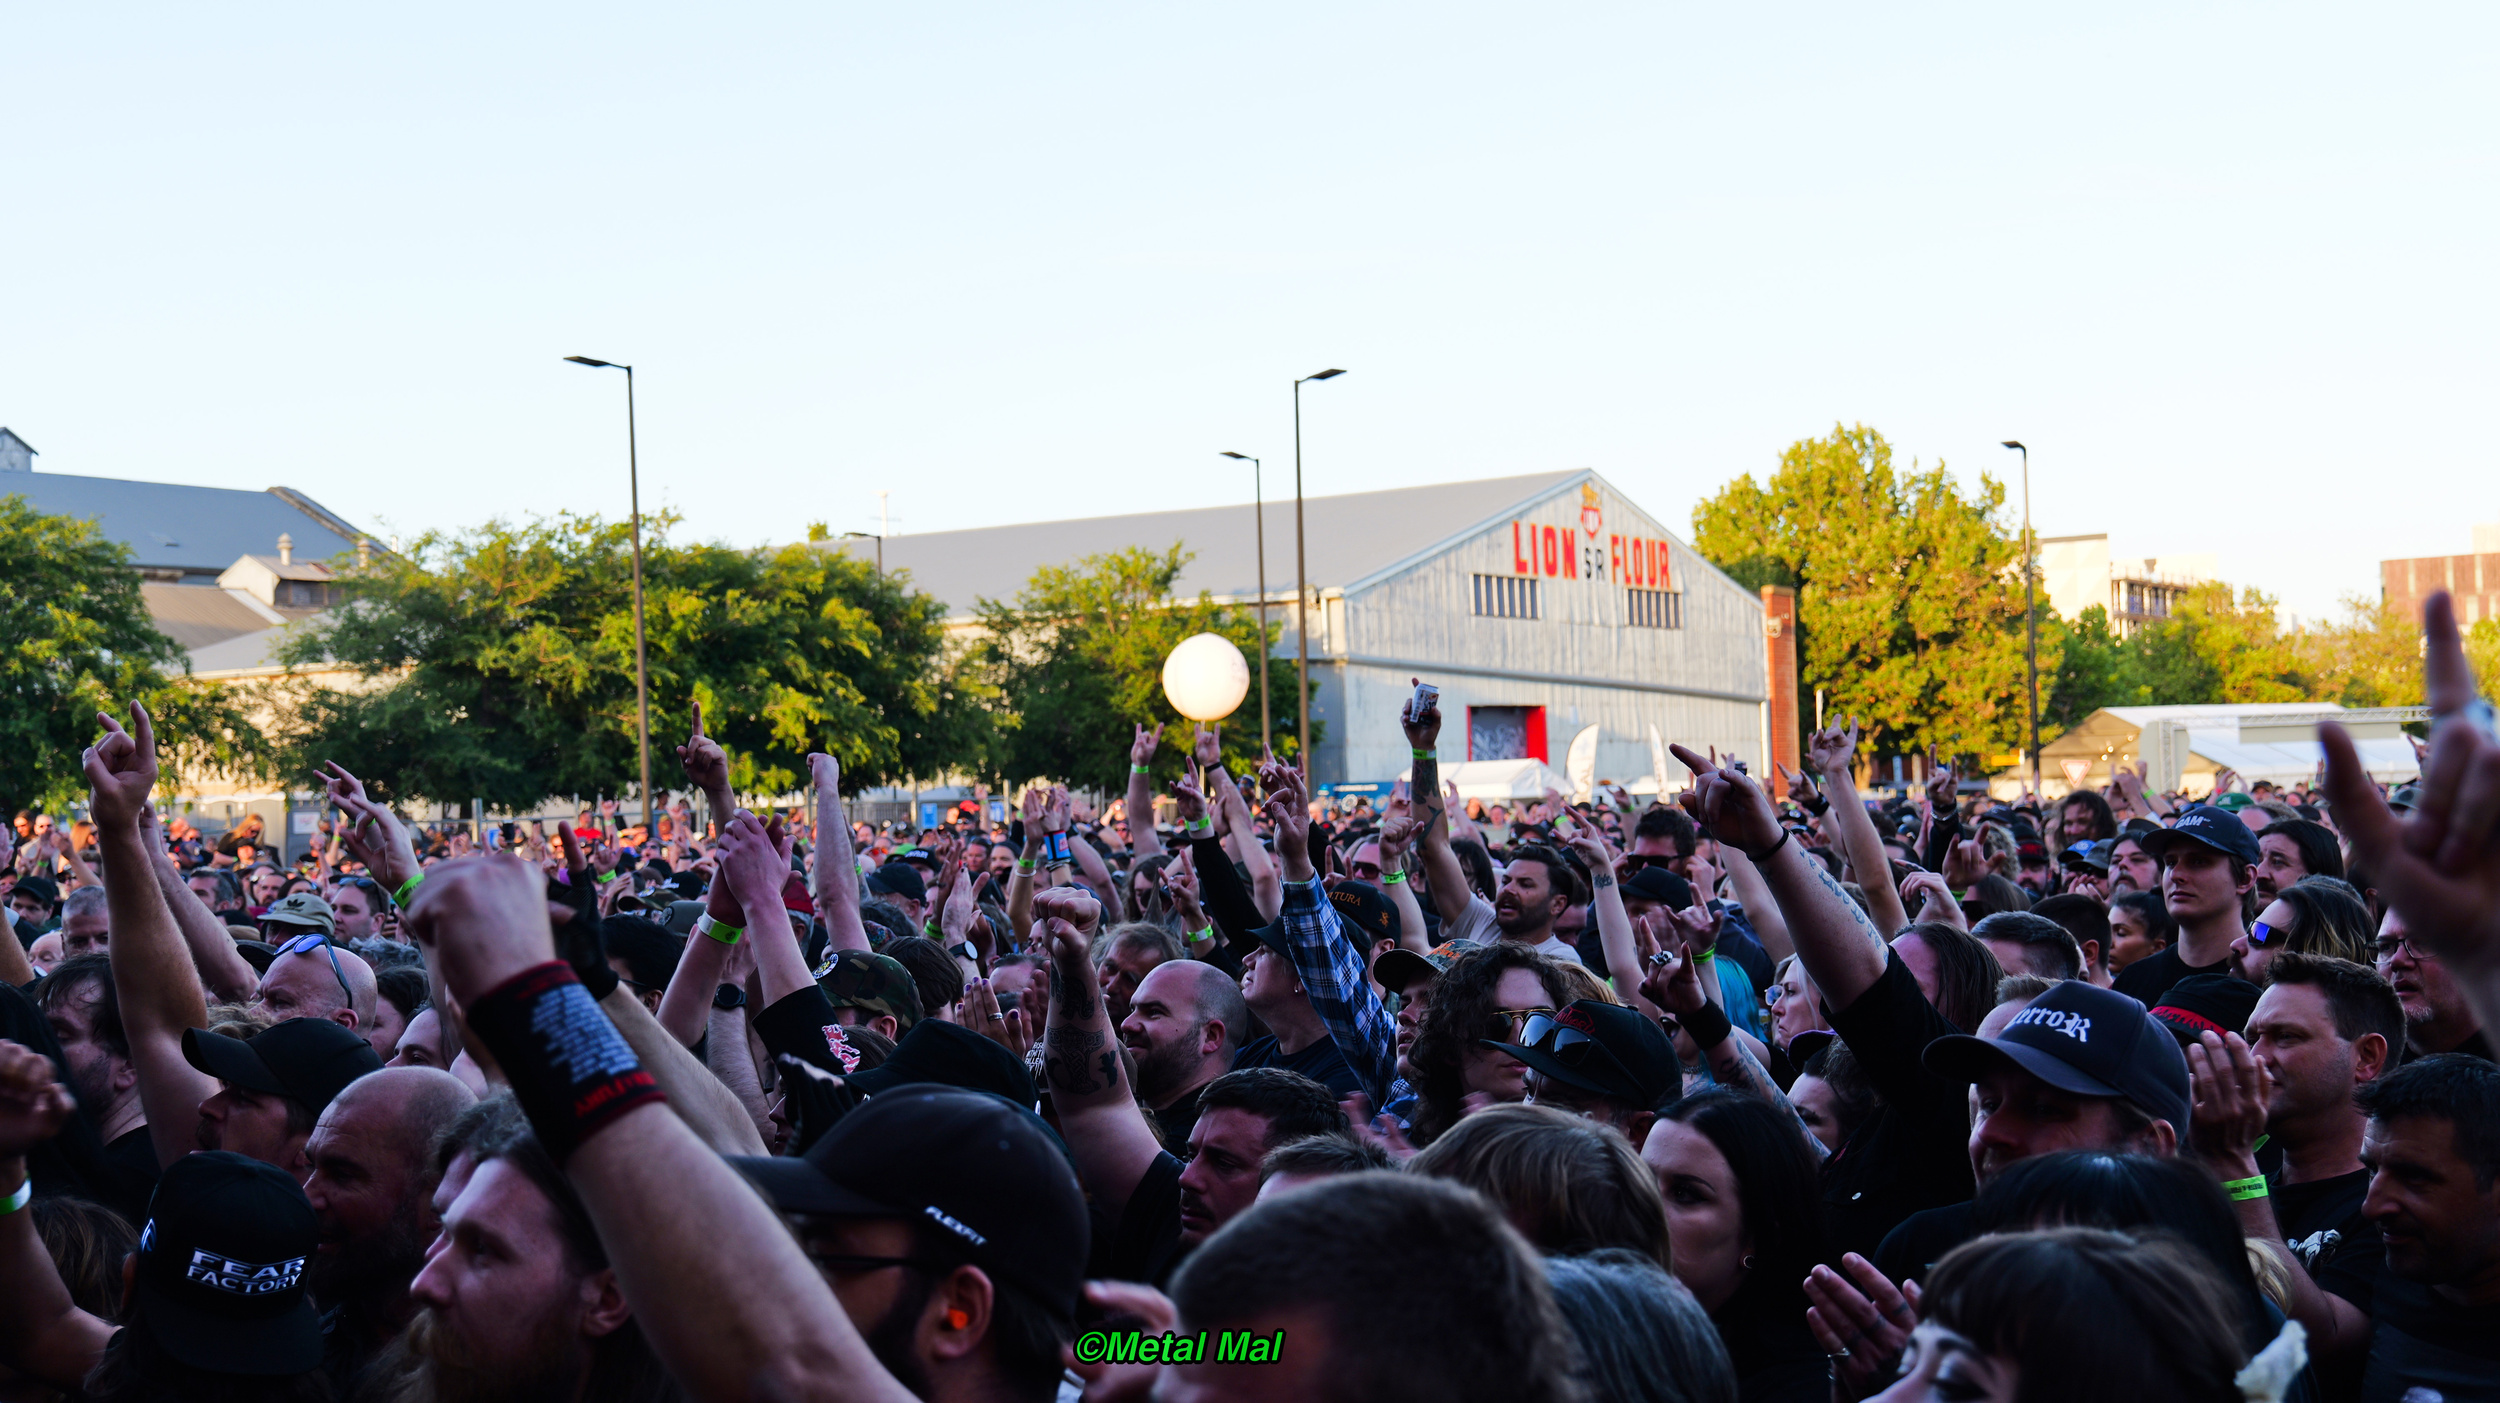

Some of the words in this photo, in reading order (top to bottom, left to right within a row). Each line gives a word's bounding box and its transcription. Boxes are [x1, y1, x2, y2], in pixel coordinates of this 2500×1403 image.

[1512, 520, 1577, 580] LION
[1584, 547, 1605, 581] SR
[1610, 533, 1671, 589] FLOUR
[187, 1265, 301, 1293] FACTORY
[192, 1250, 305, 1279] FEAR
